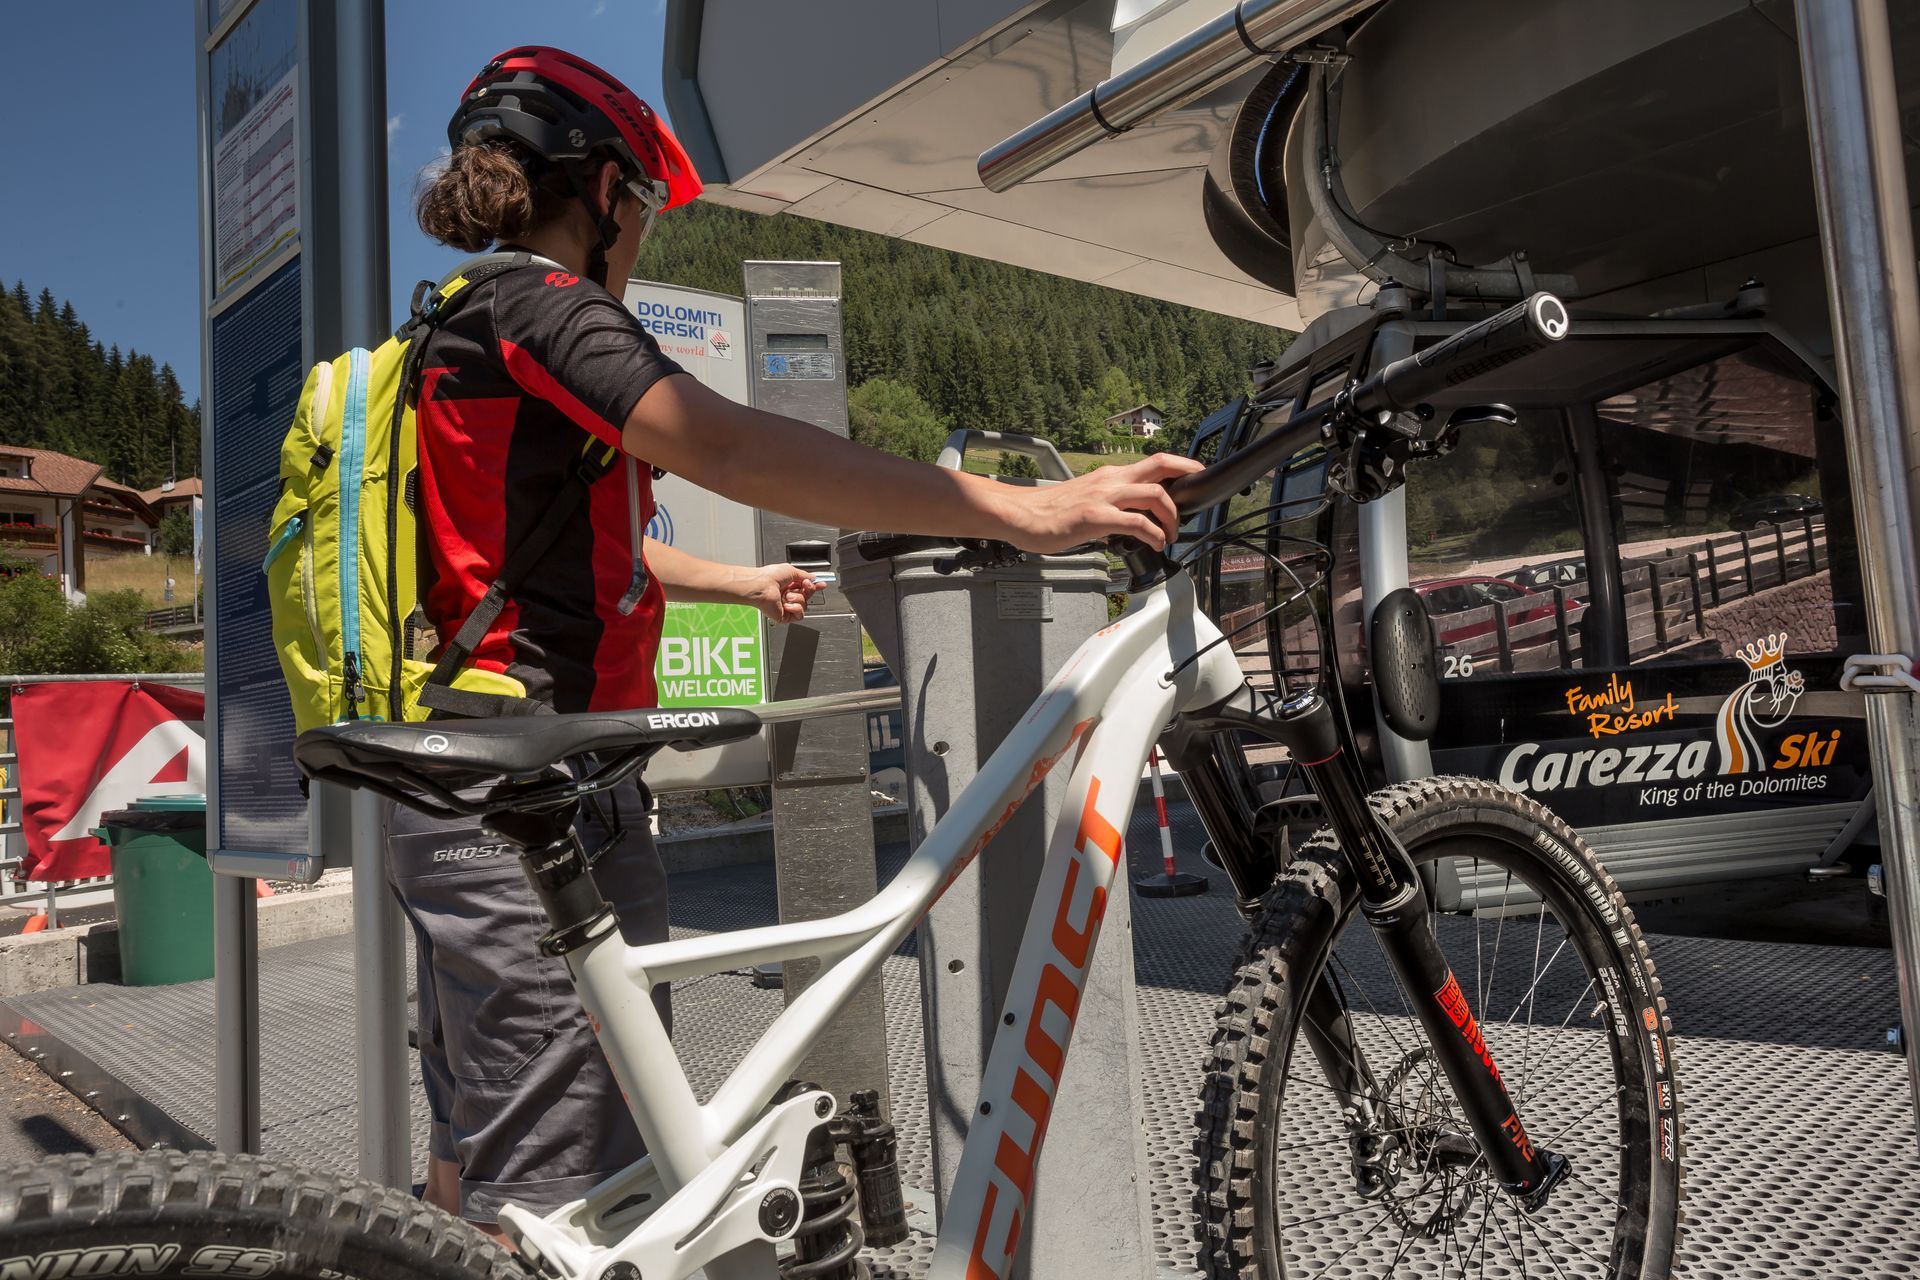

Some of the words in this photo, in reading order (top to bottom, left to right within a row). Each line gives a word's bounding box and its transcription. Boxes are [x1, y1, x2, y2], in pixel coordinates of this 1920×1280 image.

[638, 301, 721, 327] DOLOMITI
[639, 318, 704, 340] PERSKI
[676, 345, 704, 356] world
[661, 636, 756, 677] BIKE
[1444, 655, 1473, 679] 26
[662, 678, 757, 698] WELCOME
[1565, 673, 1634, 714] Family
[647, 711, 719, 729] ERGON
[1587, 693, 1679, 739] Resort
[1499, 738, 1712, 793] Carezza
[1772, 729, 1841, 771] Ski
[1639, 785, 1679, 808] King
[1683, 782, 1703, 801] of
[1706, 781, 1734, 799] the
[1739, 772, 1827, 796] Dolomites
[433, 843, 510, 863] GHOST
[1533, 830, 1591, 886] MINION
[1584, 881, 1619, 925] DHR
[0, 1243, 182, 1280] NION
[181, 1244, 285, 1277] SS
